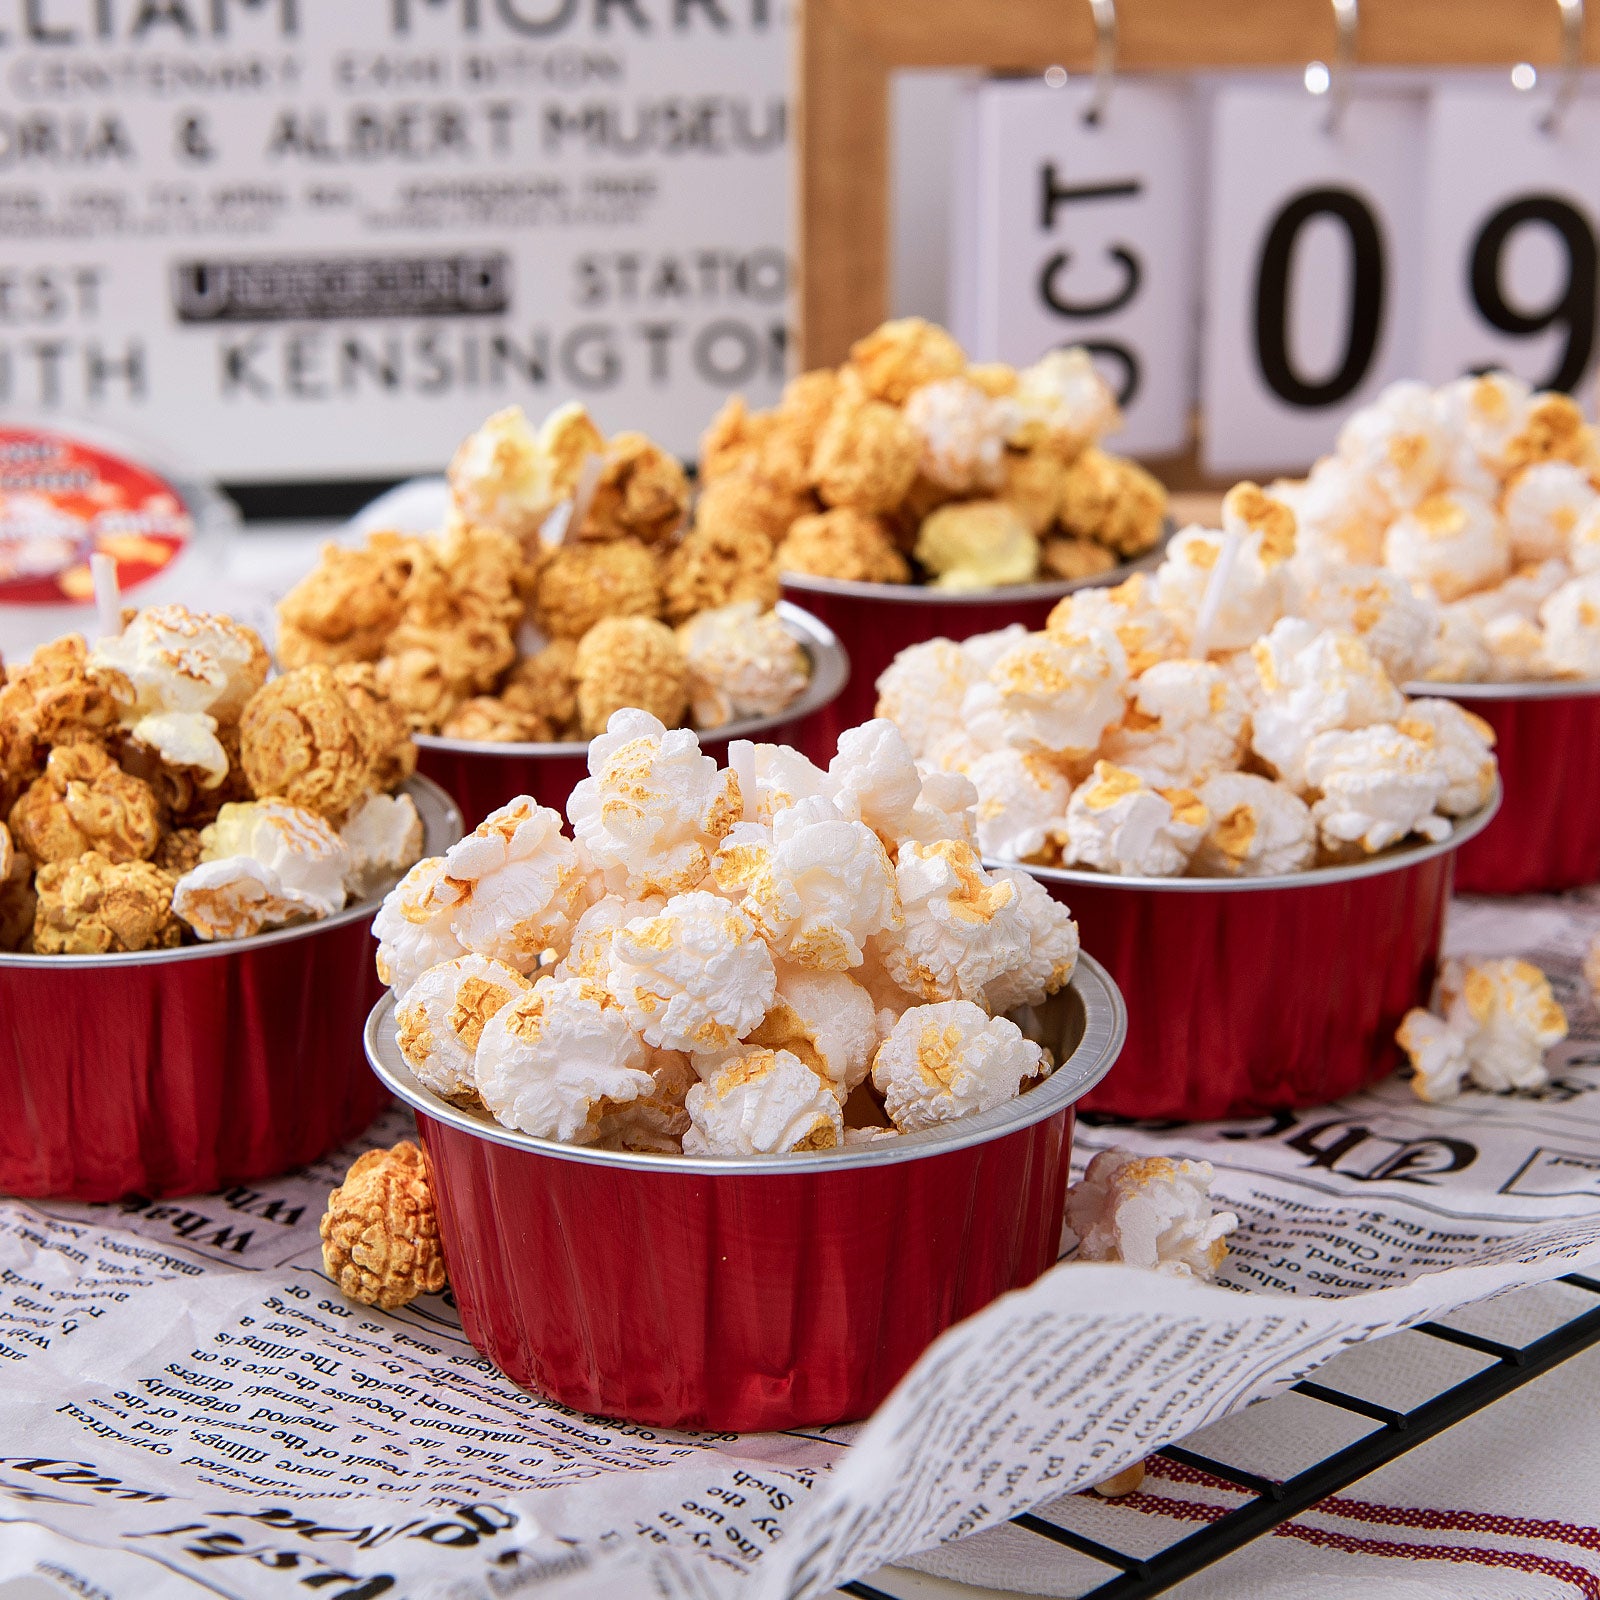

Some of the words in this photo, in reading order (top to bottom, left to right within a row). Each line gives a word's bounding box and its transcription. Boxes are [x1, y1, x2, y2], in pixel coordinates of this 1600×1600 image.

[175, 111, 214, 166] &
[266, 104, 515, 162] ALBERT
[541, 98, 785, 154] MUSEU
[574, 247, 786, 308] STATIO
[1388, 1219, 1425, 1236] for
[1288, 1230, 1380, 1261] Château
[1356, 1223, 1476, 1255] containing
[1225, 1243, 1269, 1261] vint
[1389, 1256, 1403, 1264] a
[1269, 1257, 1301, 1273] of
[1235, 1263, 1297, 1293] value,
[1307, 1271, 1374, 1290] range
[285, 1286, 311, 1300] or
[12, 1296, 55, 1314] with
[317, 1300, 354, 1319] roe
[239, 1316, 255, 1327] a
[263, 1323, 308, 1338] then
[358, 1322, 384, 1333] as
[213, 1332, 236, 1347] is
[234, 1336, 300, 1360] filling
[392, 1333, 442, 1355] such
[190, 1350, 218, 1363] on
[220, 1357, 242, 1371] is
[300, 1352, 343, 1377] The
[242, 1364, 285, 1378] rice
[373, 1361, 404, 1374] by
[164, 1364, 234, 1392] differs
[284, 1372, 320, 1391] the
[350, 1368, 419, 1400] inside.
[422, 1367, 532, 1405] optionally
[113, 1391, 149, 1409] the
[138, 1378, 241, 1414] originally
[237, 1385, 333, 1414] Uramaki
[321, 1388, 407, 1422] because
[414, 1393, 466, 1416] nori
[142, 1407, 178, 1419] of
[248, 1408, 339, 1433] method
[582, 1413, 630, 1430] rice,
[55, 1402, 172, 1456] cylindrical
[131, 1420, 178, 1437] and
[181, 1414, 267, 1434] creation
[347, 1416, 400, 1437] nori.
[409, 1418, 528, 1444] makimono
[540, 1418, 612, 1446] center
[270, 1430, 308, 1450] the
[350, 1434, 368, 1444] a
[408, 1437, 445, 1450] the
[620, 1427, 656, 1441] of
[190, 1429, 270, 1464] fillings,
[302, 1447, 340, 1459] of
[380, 1444, 409, 1456] as
[455, 1445, 510, 1463] hide
[621, 1447, 659, 1455] the
[275, 1460, 337, 1478] more
[340, 1454, 410, 1477] result
[518, 1458, 543, 1467] to
[339, 1474, 369, 1485] or
[706, 1487, 746, 1509] the
[730, 1469, 794, 1512] Such
[658, 1512, 684, 1529] in
[681, 1501, 724, 1526] use
